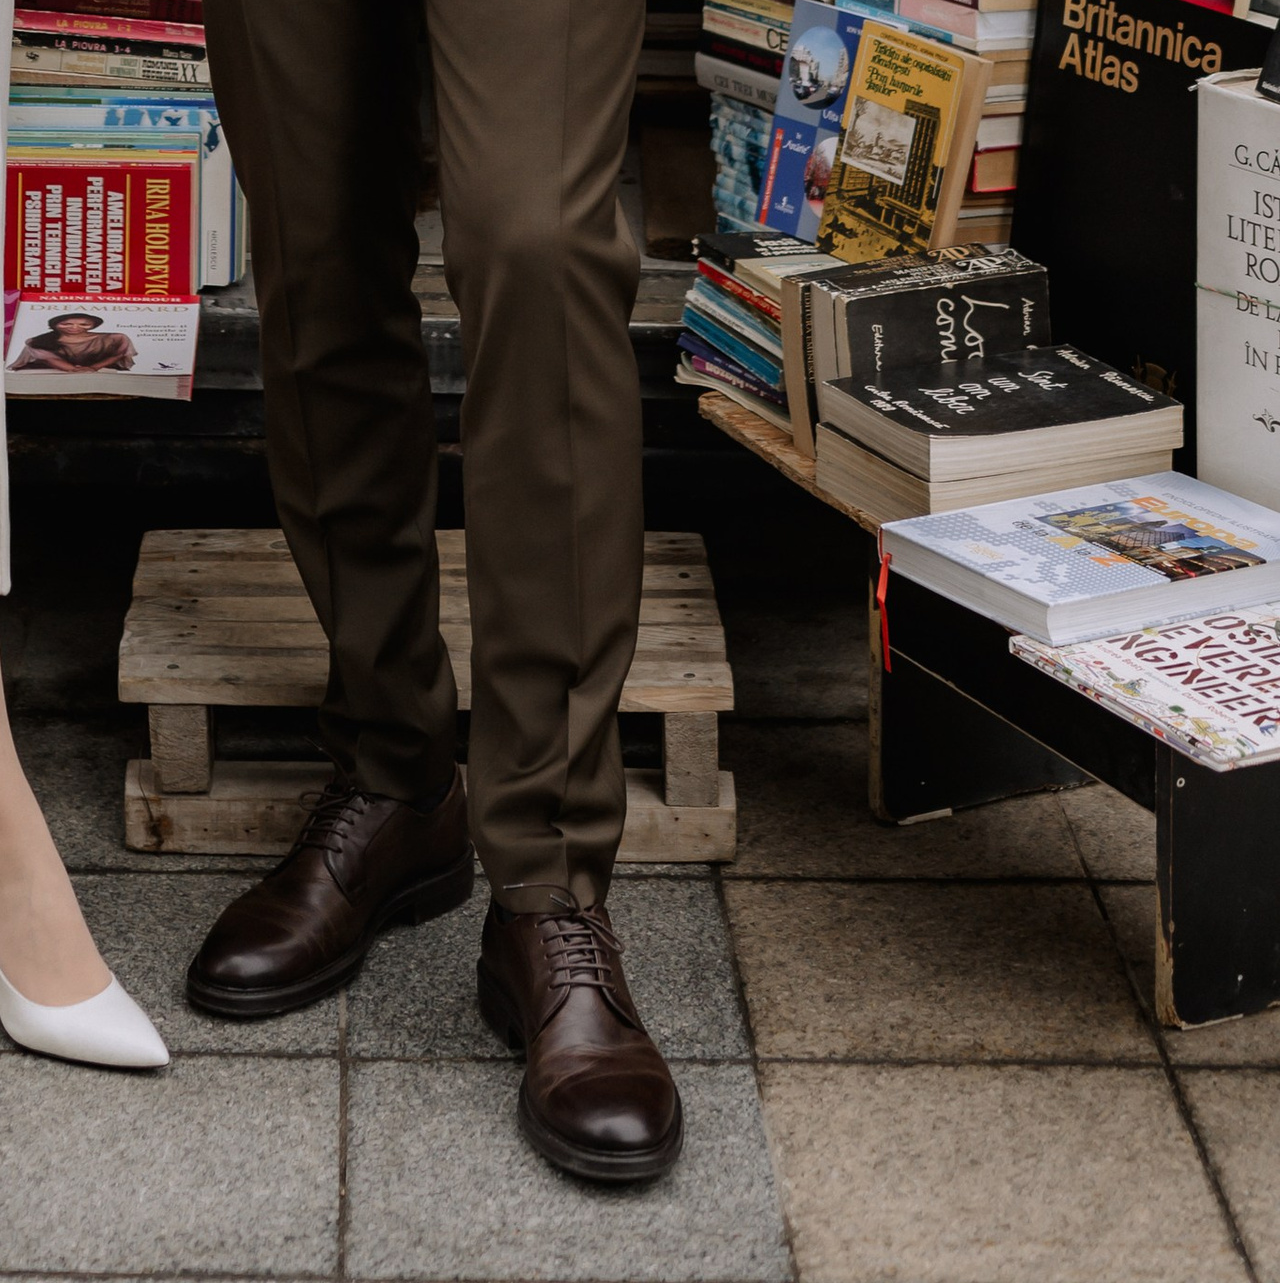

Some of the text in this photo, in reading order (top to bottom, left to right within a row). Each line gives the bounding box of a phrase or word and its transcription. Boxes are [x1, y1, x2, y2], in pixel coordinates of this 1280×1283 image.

[54, 39, 66, 48] LA
[71, 41, 107, 53] PIOVRA
[1058, 32, 1140, 95] Atlas
[1234, 144, 1253, 168] G.
[45, 184, 63, 219] PRIN
[145, 178, 171, 220] IRINA
[45, 222, 62, 276] TEHNICI
[65, 197, 83, 284] INDIVIDUALE
[106, 190, 125, 291] AMELIORAREA
[1226, 214, 1280, 252] LITE
[29, 304, 189, 313] DREAMBOARD
[38, 294, 93, 302] NADINE
[1236, 290, 1260, 317] DE
[806, 337, 817, 385] EMINESCU
[1244, 341, 1268, 372] ÎN
[918, 388, 976, 416] liber
[1129, 495, 1259, 551] Europa
